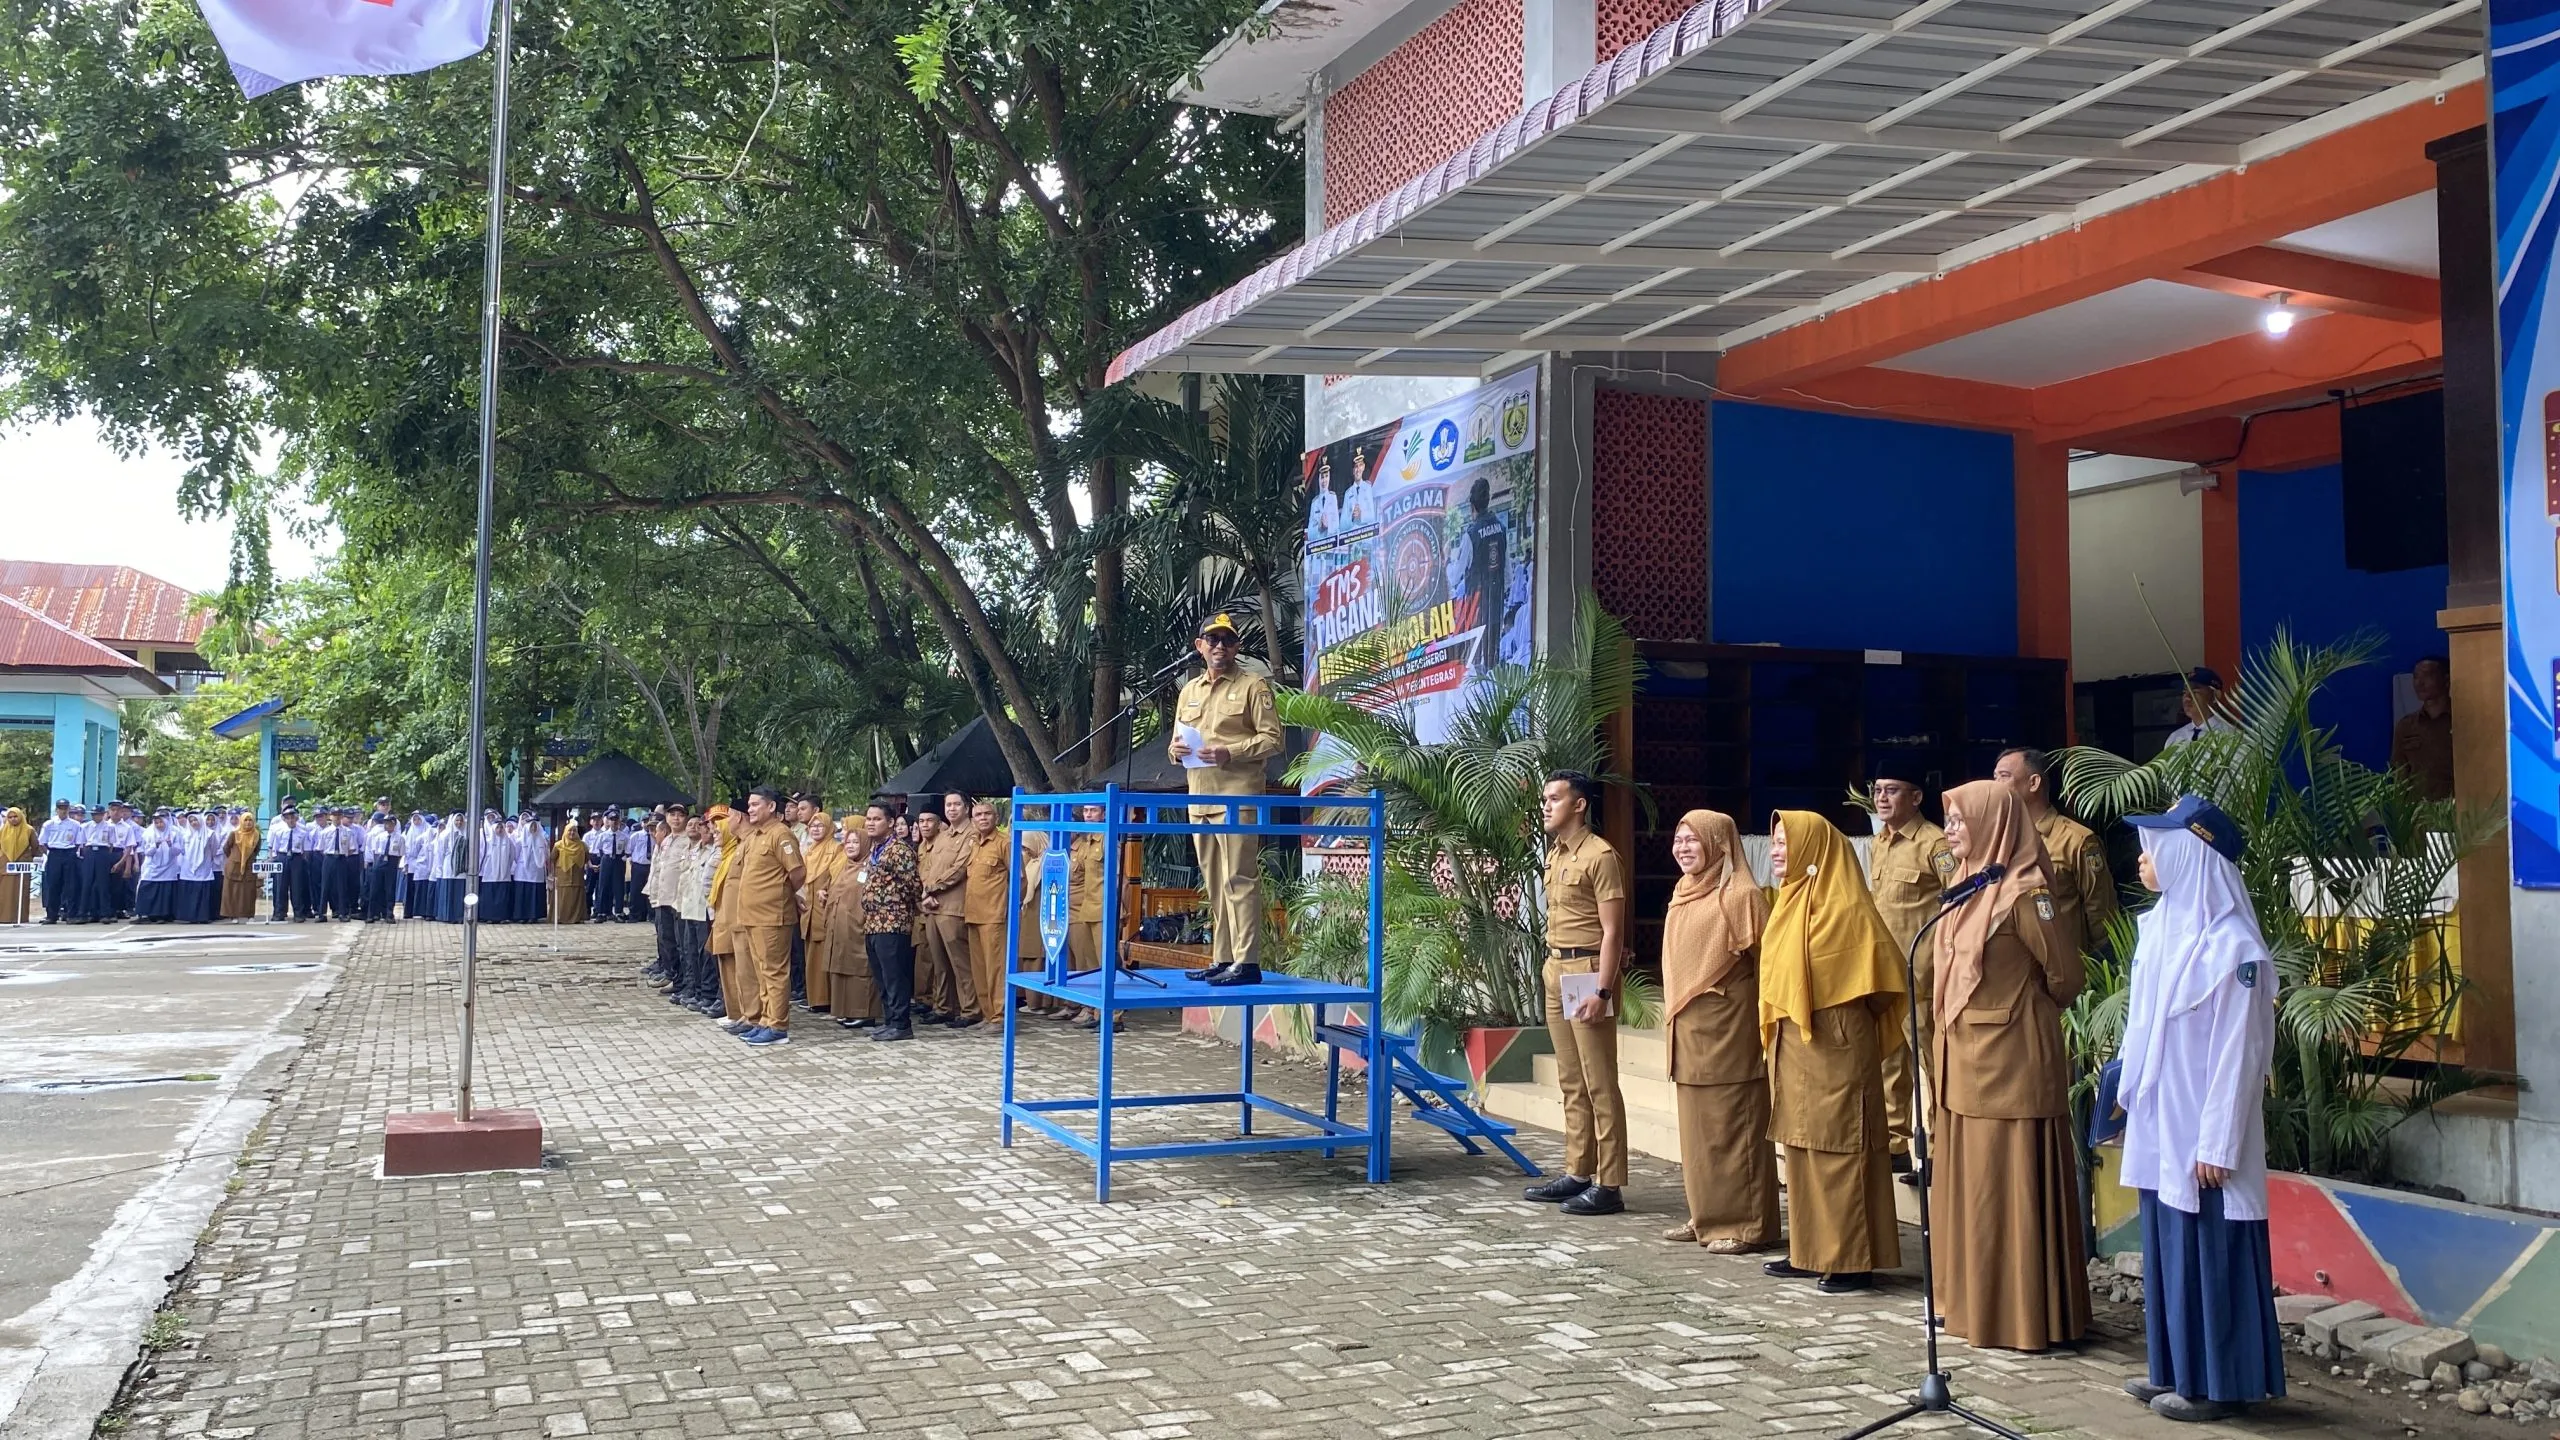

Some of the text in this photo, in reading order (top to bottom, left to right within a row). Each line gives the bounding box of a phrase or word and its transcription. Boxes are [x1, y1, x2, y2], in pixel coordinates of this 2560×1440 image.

[1384, 489, 1444, 523] TAGANA
[1478, 524, 1503, 539] TAGANA
[1326, 565, 1361, 611] TMS
[1312, 588, 1385, 651] TAGANA
[15, 863, 39, 872] VIII-7
[261, 863, 282, 872] VIII-8
